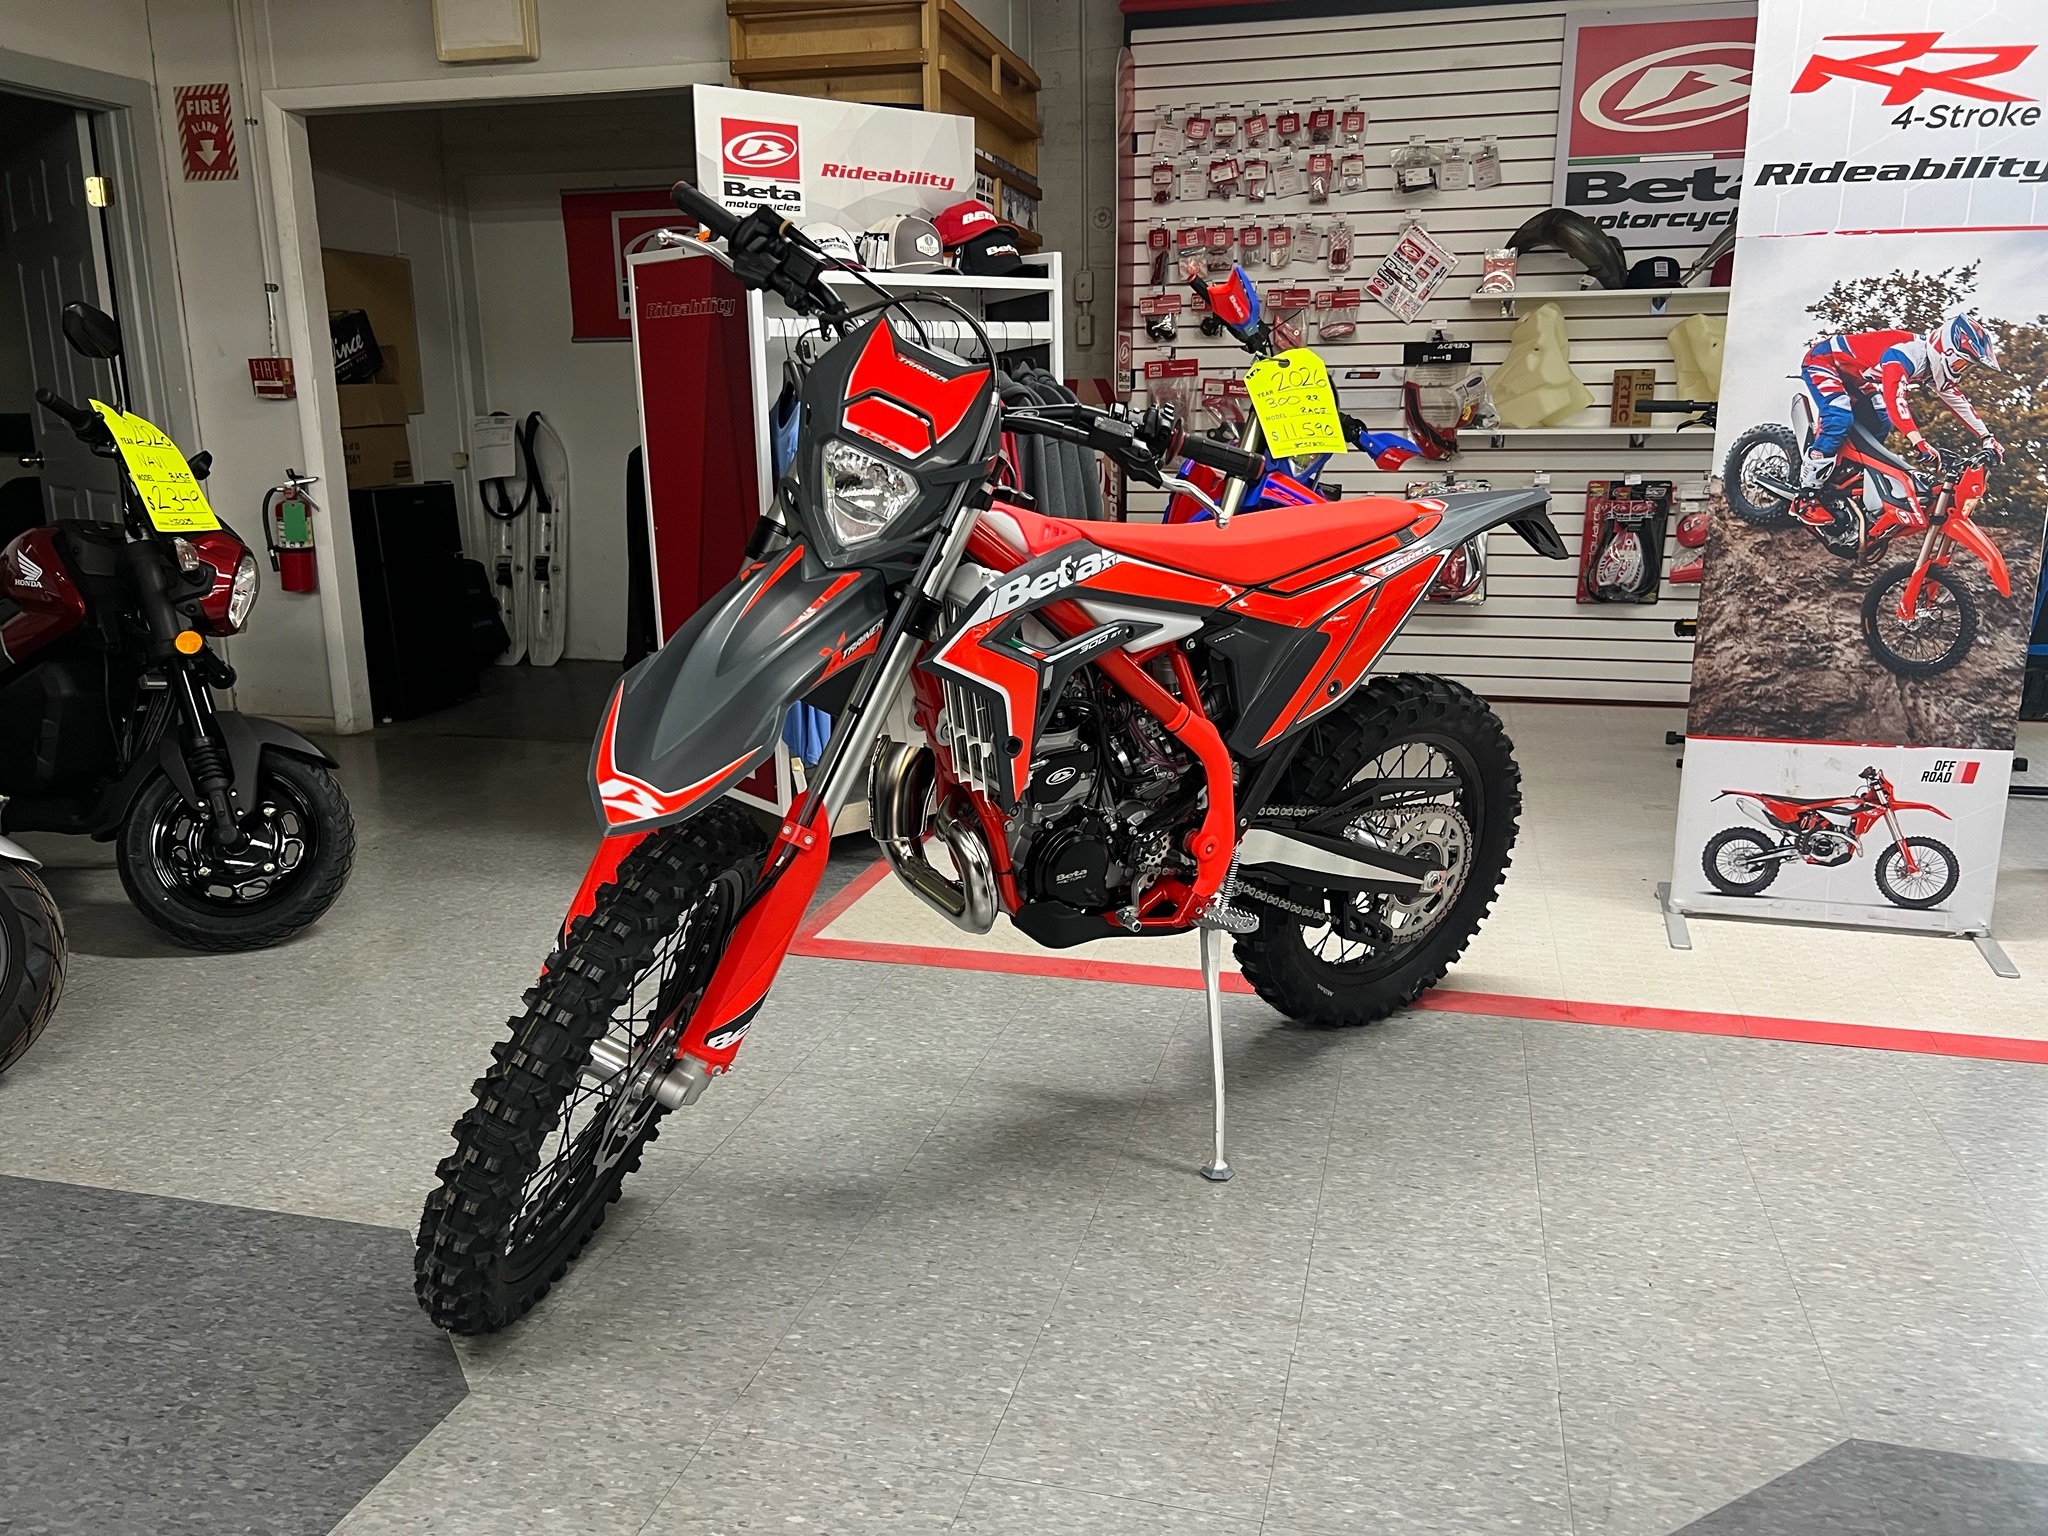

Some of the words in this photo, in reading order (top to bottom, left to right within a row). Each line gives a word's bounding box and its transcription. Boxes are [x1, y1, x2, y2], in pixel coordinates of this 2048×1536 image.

[186, 98, 220, 115] FIRE
[1891, 102, 2042, 130] 4-Stroke
[190, 121, 219, 135] ALARM
[821, 163, 955, 191] Rideability
[1754, 156, 2048, 187] Rideability
[723, 181, 801, 202] Beta
[646, 298, 736, 320] Rideability
[332, 334, 364, 364] ince
[252, 360, 280, 379] FIRE
[1257, 389, 1275, 398] YEAR
[1271, 366, 1328, 393] 2026
[1265, 395, 1301, 409] 300
[1618, 375, 1632, 423] RTIC
[1266, 413, 1287, 421] MODEL
[136, 473, 155, 482] MODEL
[14, 579, 43, 588] HONDA
[842, 618, 884, 660] TRAINER
[1934, 760, 1957, 772] OFF
[1920, 771, 1952, 783] ROAD
